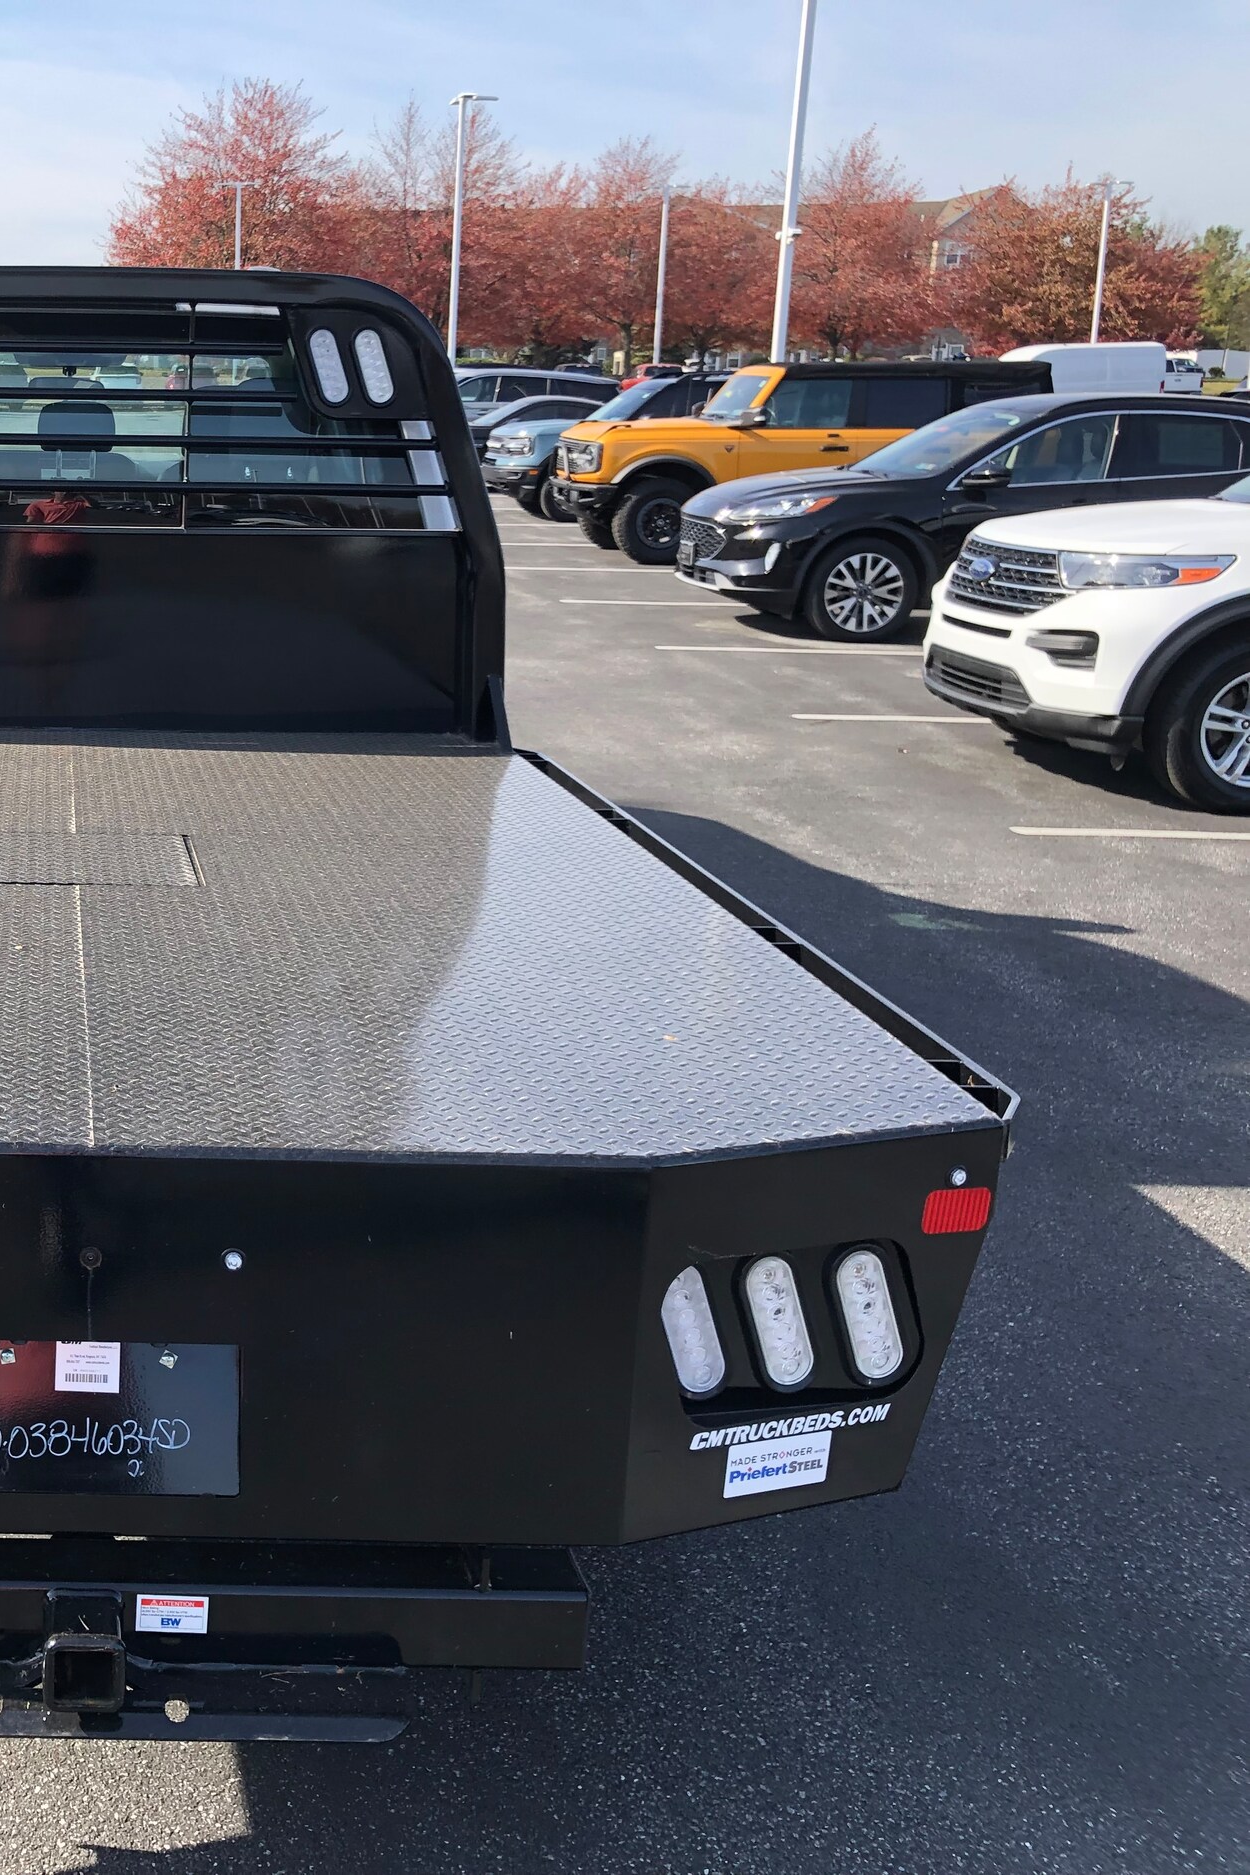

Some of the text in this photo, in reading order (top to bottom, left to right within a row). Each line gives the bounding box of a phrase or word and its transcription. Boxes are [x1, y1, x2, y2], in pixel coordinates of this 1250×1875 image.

[688, 1403, 892, 1451] CMTRUCKBEDS.COM
[730, 1455, 758, 1467] MADE
[760, 1446, 813, 1462] STRONGER
[158, 1600, 195, 1608] ATTENTION
